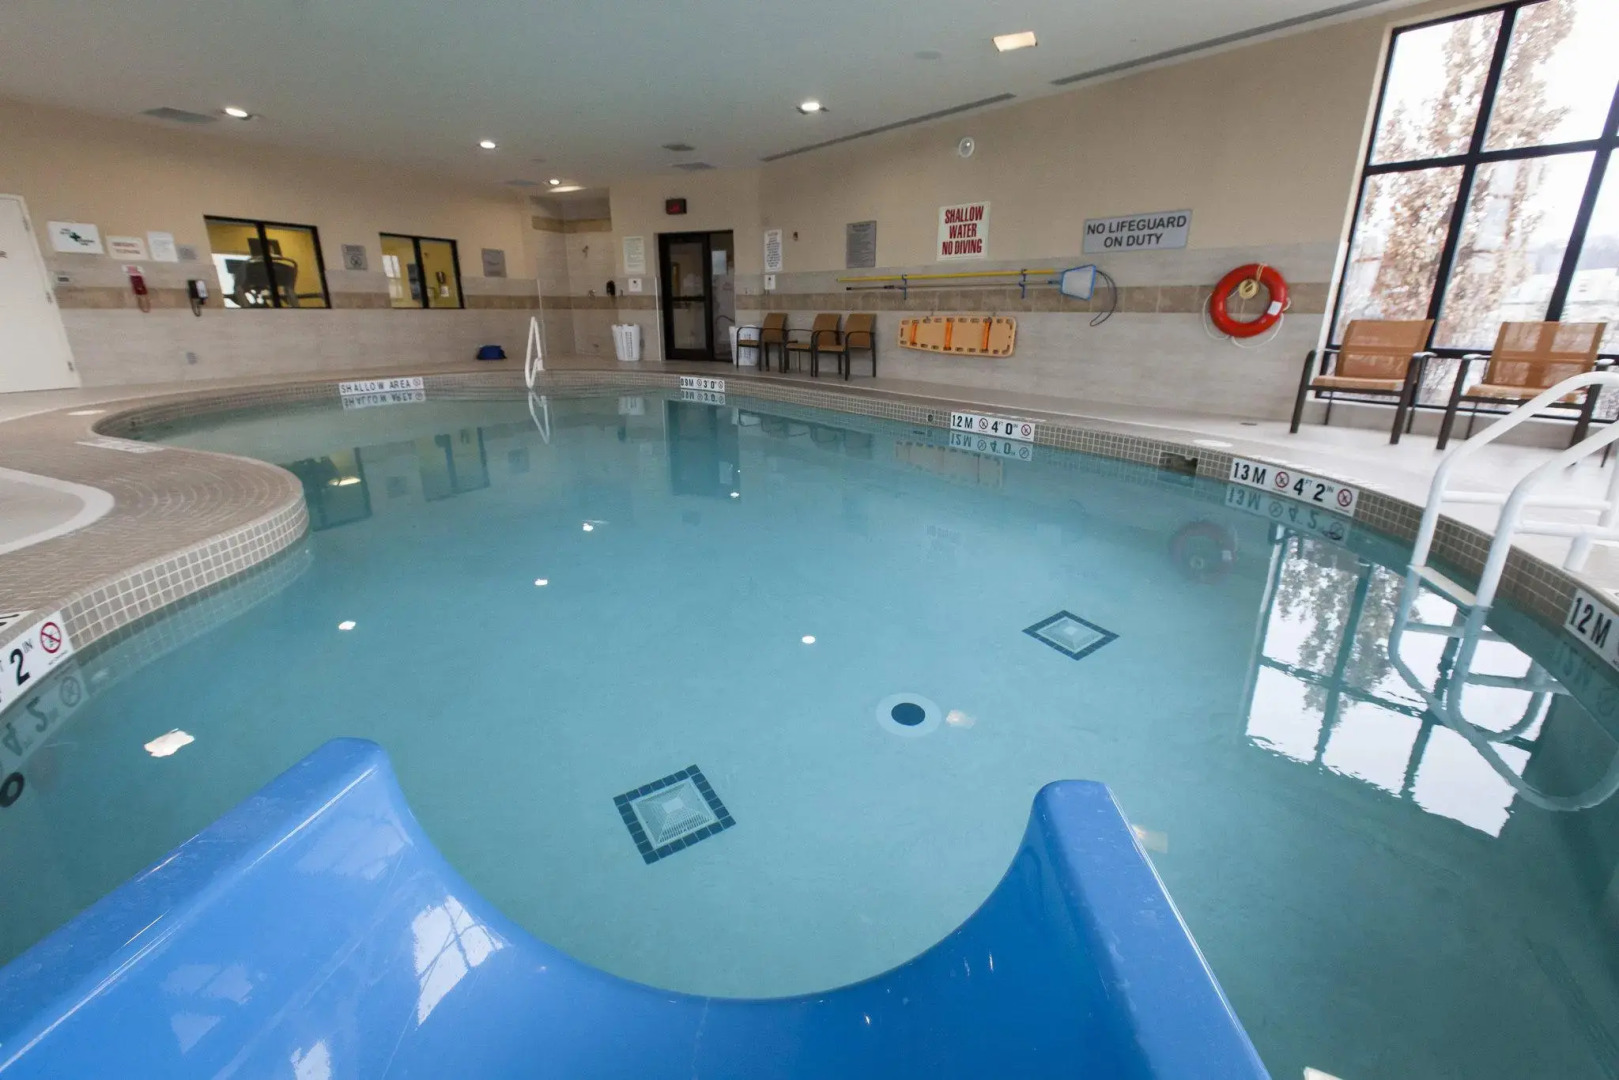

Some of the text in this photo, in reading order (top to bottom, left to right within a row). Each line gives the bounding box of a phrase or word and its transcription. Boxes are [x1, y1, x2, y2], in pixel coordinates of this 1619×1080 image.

[944, 205, 984, 224] SHALLOW
[949, 223, 977, 239] WATER
[1087, 215, 1187, 235] NO LIFEGUARD
[942, 238, 982, 255] NO DIVING
[1103, 233, 1163, 248] ON DUTY
[341, 379, 411, 393] SHALLOW AREA
